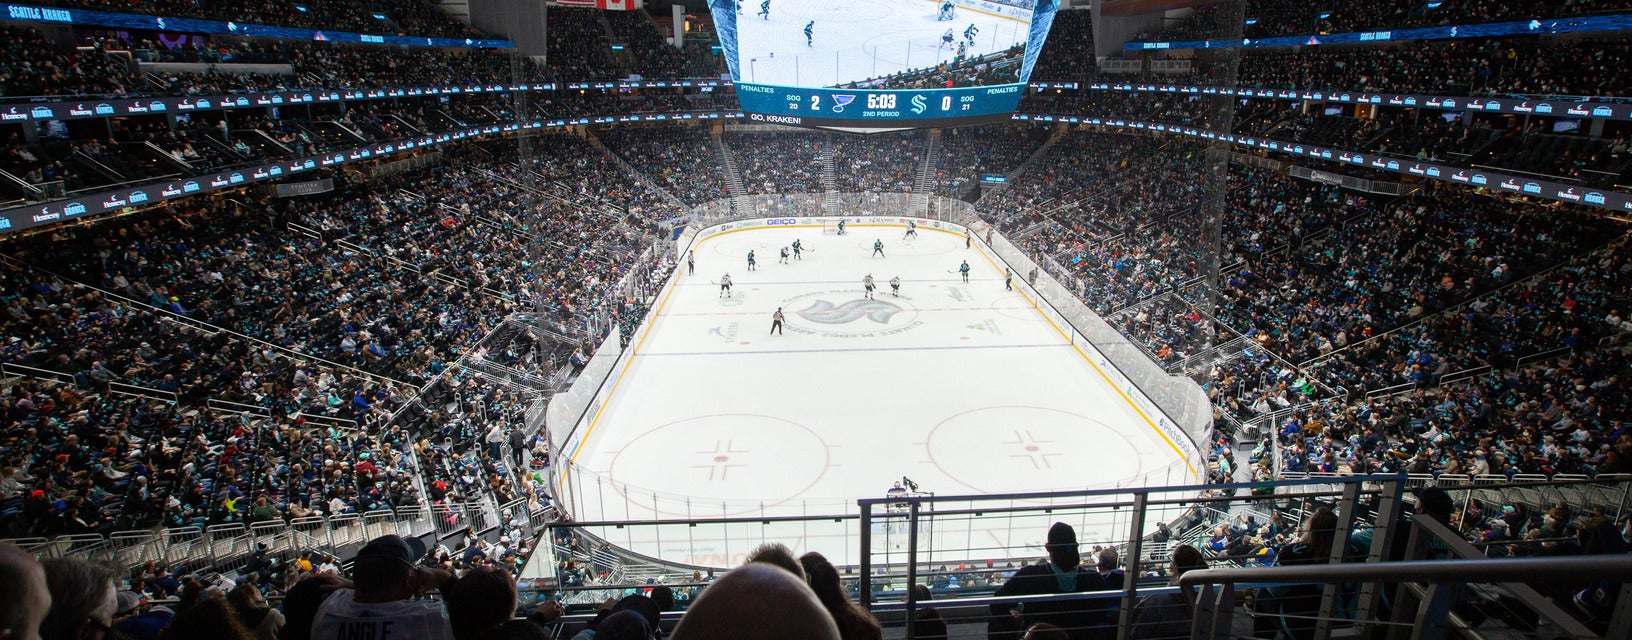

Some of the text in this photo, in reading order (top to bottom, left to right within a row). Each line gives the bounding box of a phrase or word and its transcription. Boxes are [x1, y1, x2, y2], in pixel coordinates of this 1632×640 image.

[8, 5, 72, 22] SEATTLE KRAKEN
[740, 84, 775, 94] PENALTIES
[987, 86, 1018, 95] PENALTIES
[786, 94, 801, 102] SOG
[867, 93, 897, 109] 5:03
[789, 102, 799, 110] 20
[810, 95, 820, 111] 2
[941, 95, 951, 111] 0
[961, 103, 971, 111] 21
[766, 115, 801, 124] KRAKEN!
[766, 218, 797, 226] GEICO
